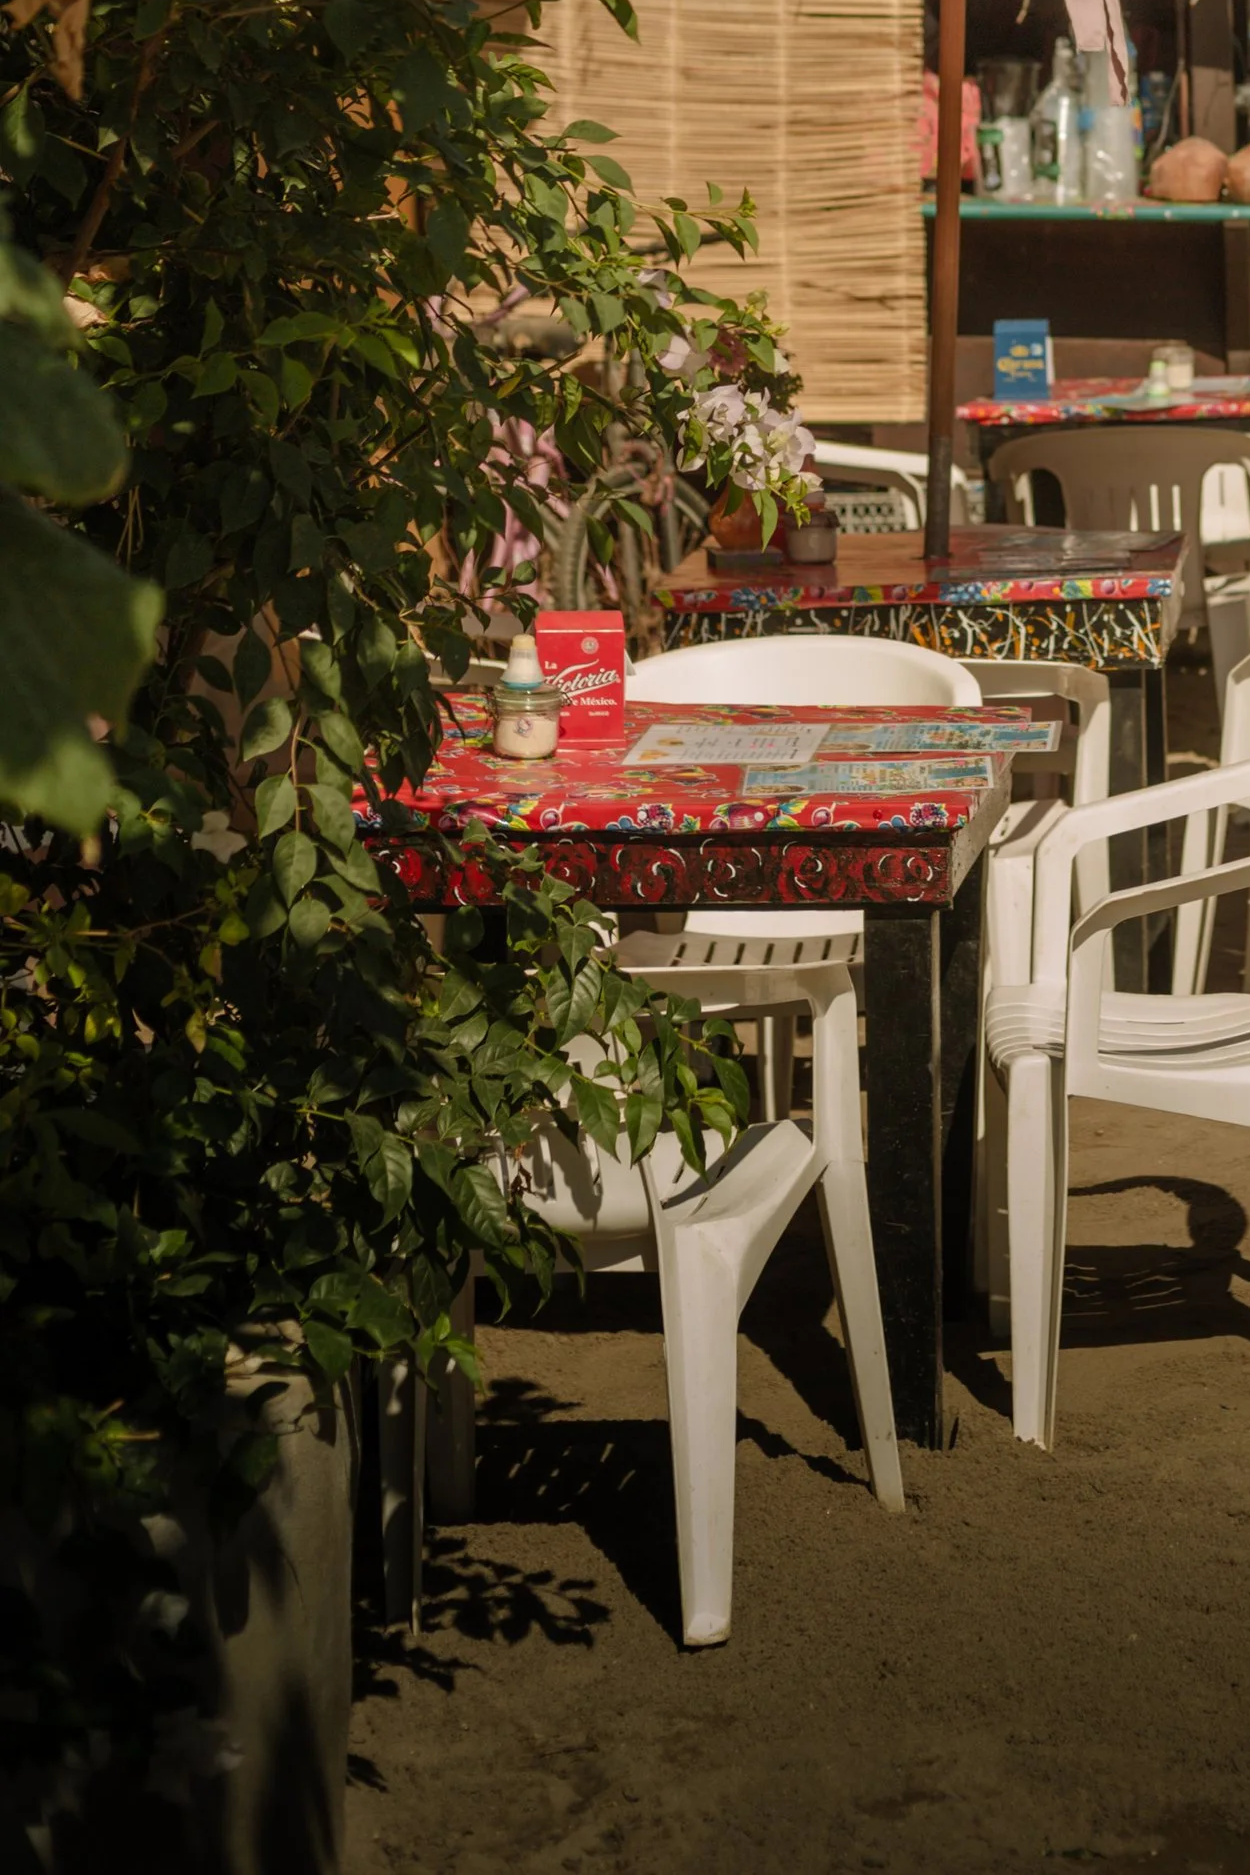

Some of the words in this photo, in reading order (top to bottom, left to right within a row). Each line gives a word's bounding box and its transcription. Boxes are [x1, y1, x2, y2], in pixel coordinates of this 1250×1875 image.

[544, 661, 557, 670] La
[544, 658, 618, 698] Victoria
[580, 696, 617, 706] México.
